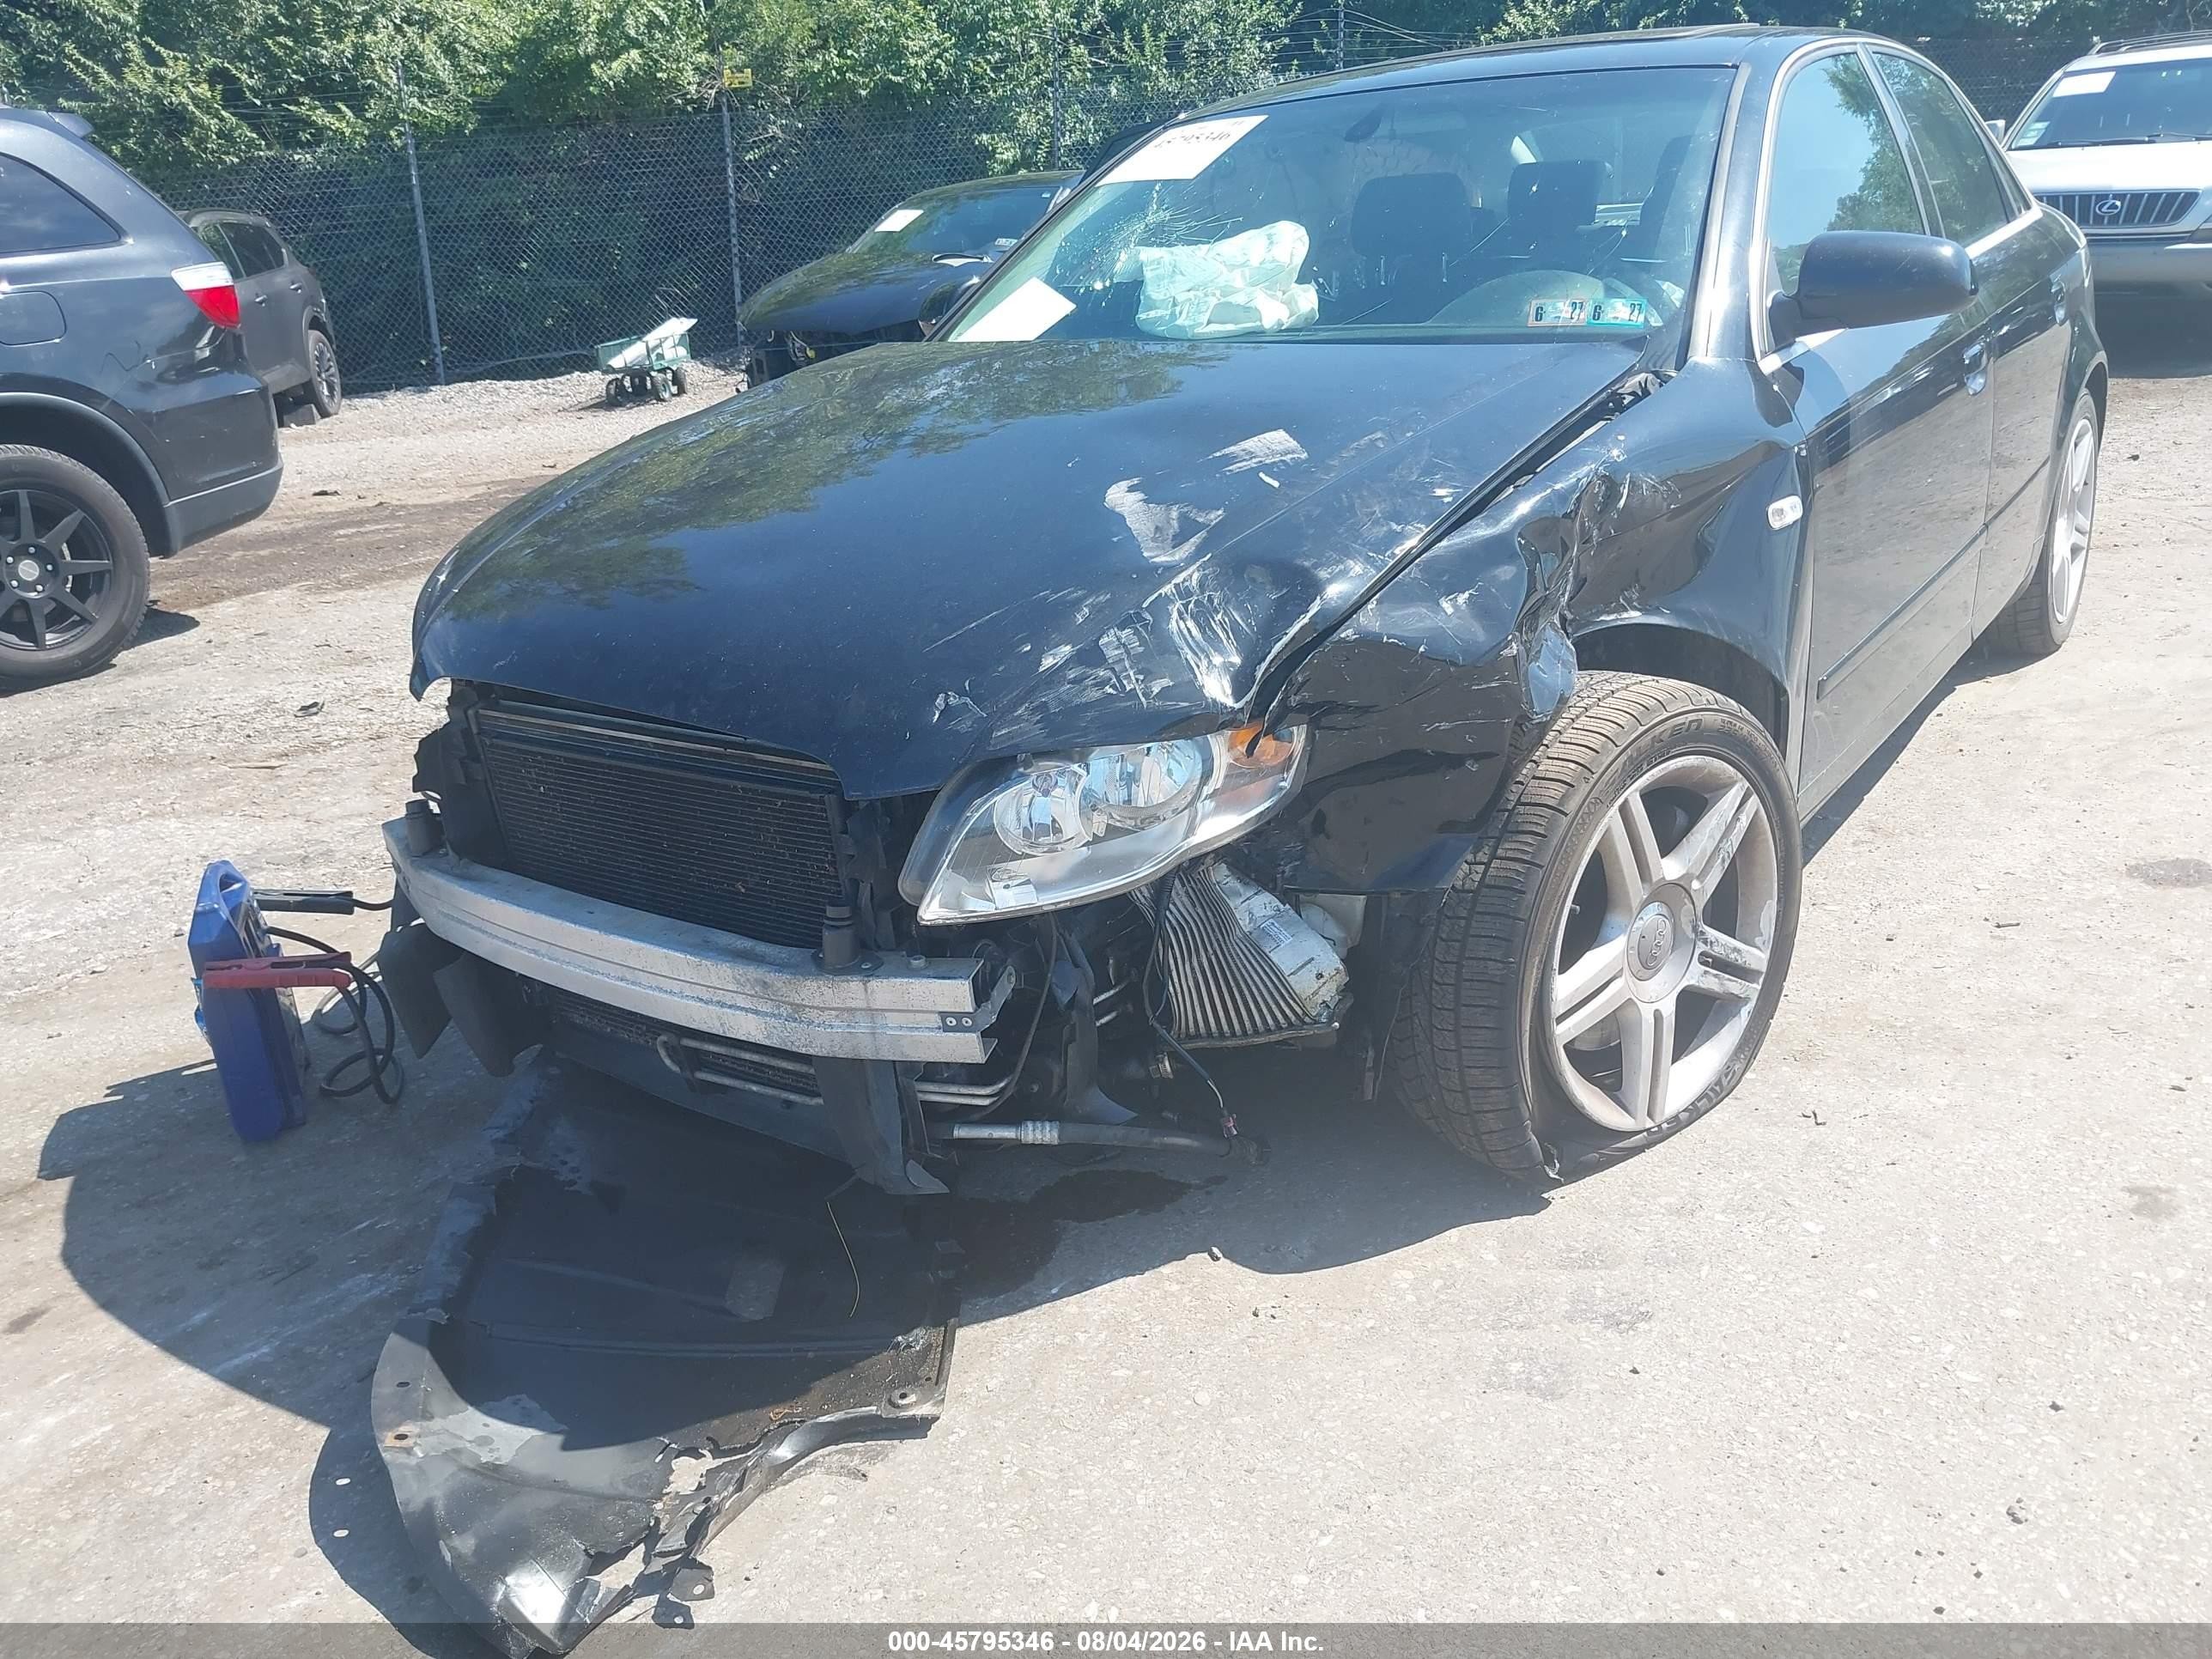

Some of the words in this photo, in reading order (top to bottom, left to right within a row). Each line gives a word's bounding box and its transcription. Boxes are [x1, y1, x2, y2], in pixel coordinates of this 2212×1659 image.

[1534, 306, 1544, 322] 6
[1570, 301, 1583, 321] 27
[1592, 305, 1602, 321] 6
[1628, 302, 1643, 323] 27
